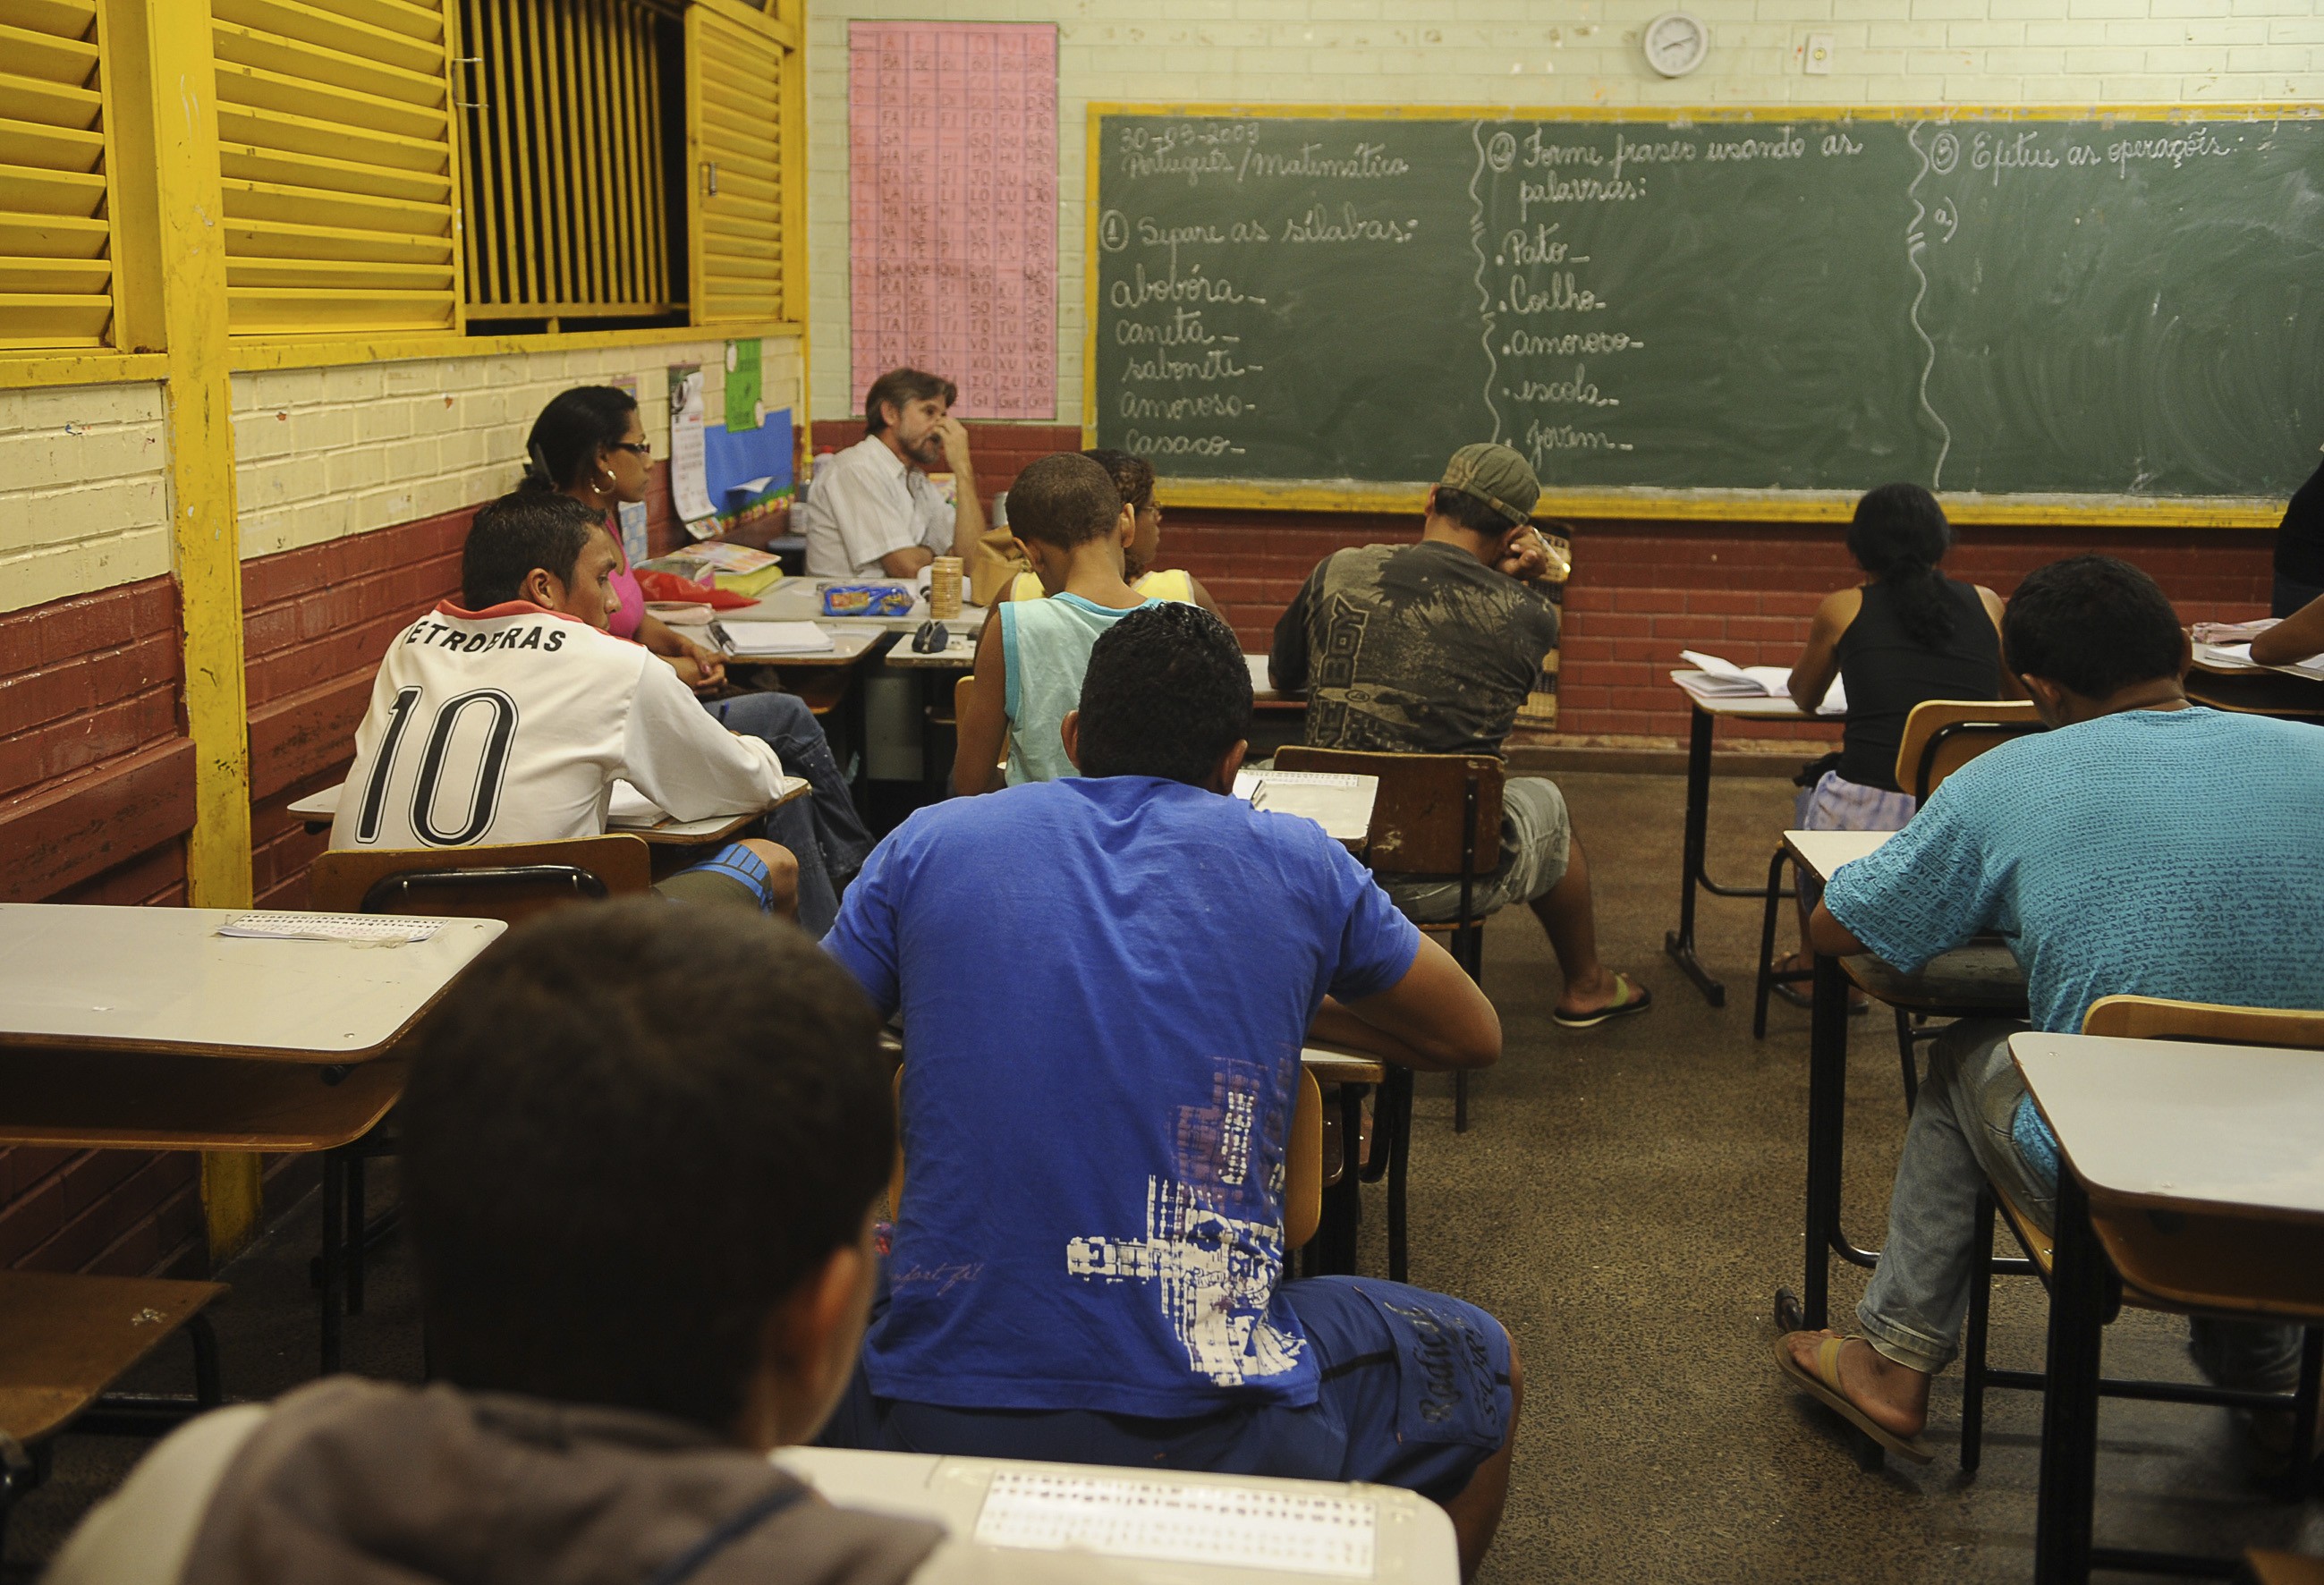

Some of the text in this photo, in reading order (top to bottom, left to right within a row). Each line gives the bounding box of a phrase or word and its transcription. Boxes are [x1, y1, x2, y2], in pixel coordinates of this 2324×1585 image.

[1523, 127, 1604, 167] Forme
[1608, 132, 1697, 180] frases
[1706, 125, 1806, 162] usando
[1820, 133, 1863, 157] as
[1972, 131, 2060, 186] Efetue
[2067, 146, 2102, 166] as
[1520, 170, 1646, 222] palavras:
[1139, 216, 1225, 268] Separe
[1230, 222, 1269, 243] as
[1283, 202, 1419, 243] sílabas:
[399, 621, 566, 653] ETROBRAS
[356, 685, 520, 848] 10
